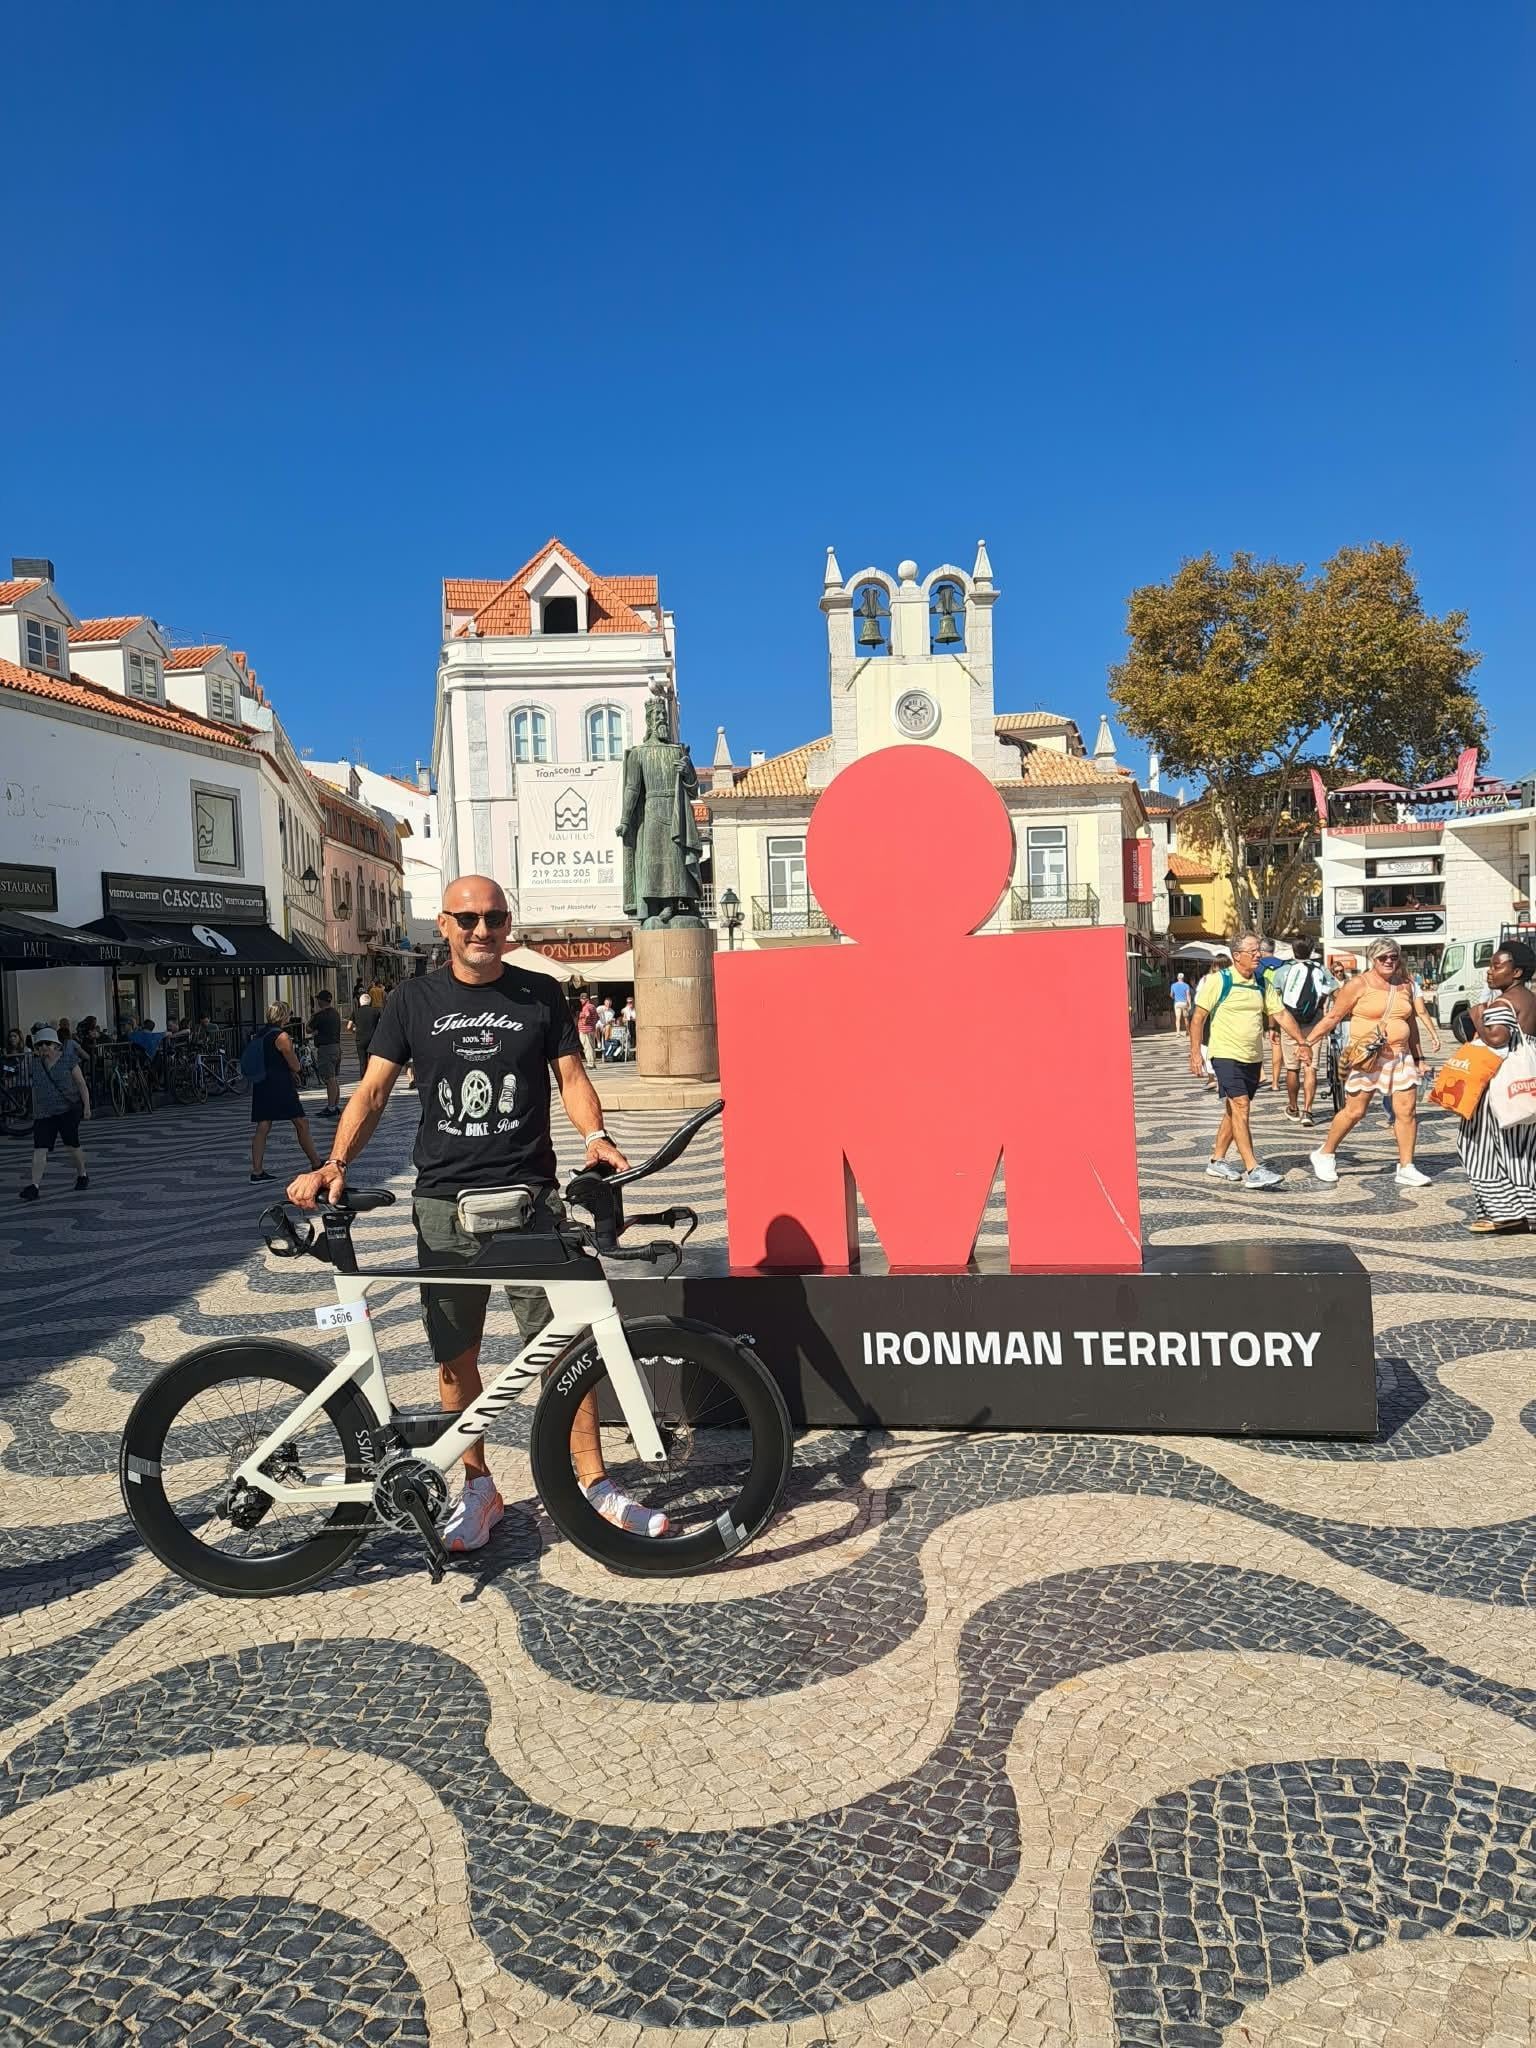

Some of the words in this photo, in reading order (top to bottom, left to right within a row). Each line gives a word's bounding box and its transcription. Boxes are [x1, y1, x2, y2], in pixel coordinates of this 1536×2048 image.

[536, 766, 581, 778] Transcend
[531, 851, 566, 865] FOR
[573, 850, 614, 864] SALE
[532, 869, 549, 878] 219
[553, 869, 570, 877] 233
[573, 869, 591, 877] 205
[0, 881, 49, 893] STAURANT
[109, 889, 134, 899] VISITOR
[135, 891, 160, 900] CENTER
[162, 888, 223, 909] CASCAIS
[224, 897, 245, 906] VISITOR
[245, 899, 264, 907] CENTER
[23, 941, 50, 958] PAUL
[100, 946, 121, 960] PAUL
[167, 968, 216, 976] CASCAIS
[224, 967, 267, 975] VISITOR
[274, 966, 308, 974] CENTER
[431, 1012, 524, 1036] Triathlon
[462, 1036, 479, 1044] 100%
[1510, 1080, 1536, 1095] Roya
[437, 1119, 462, 1136] Swim
[465, 1122, 489, 1137] BIKE
[494, 1118, 520, 1134] Run
[862, 1331, 1063, 1366] IRONMAN
[1073, 1331, 1322, 1367] TERRITORY
[556, 1353, 593, 1396] SWISS
[457, 1334, 577, 1435] CANYON
[355, 1429, 376, 1475] SWISS
